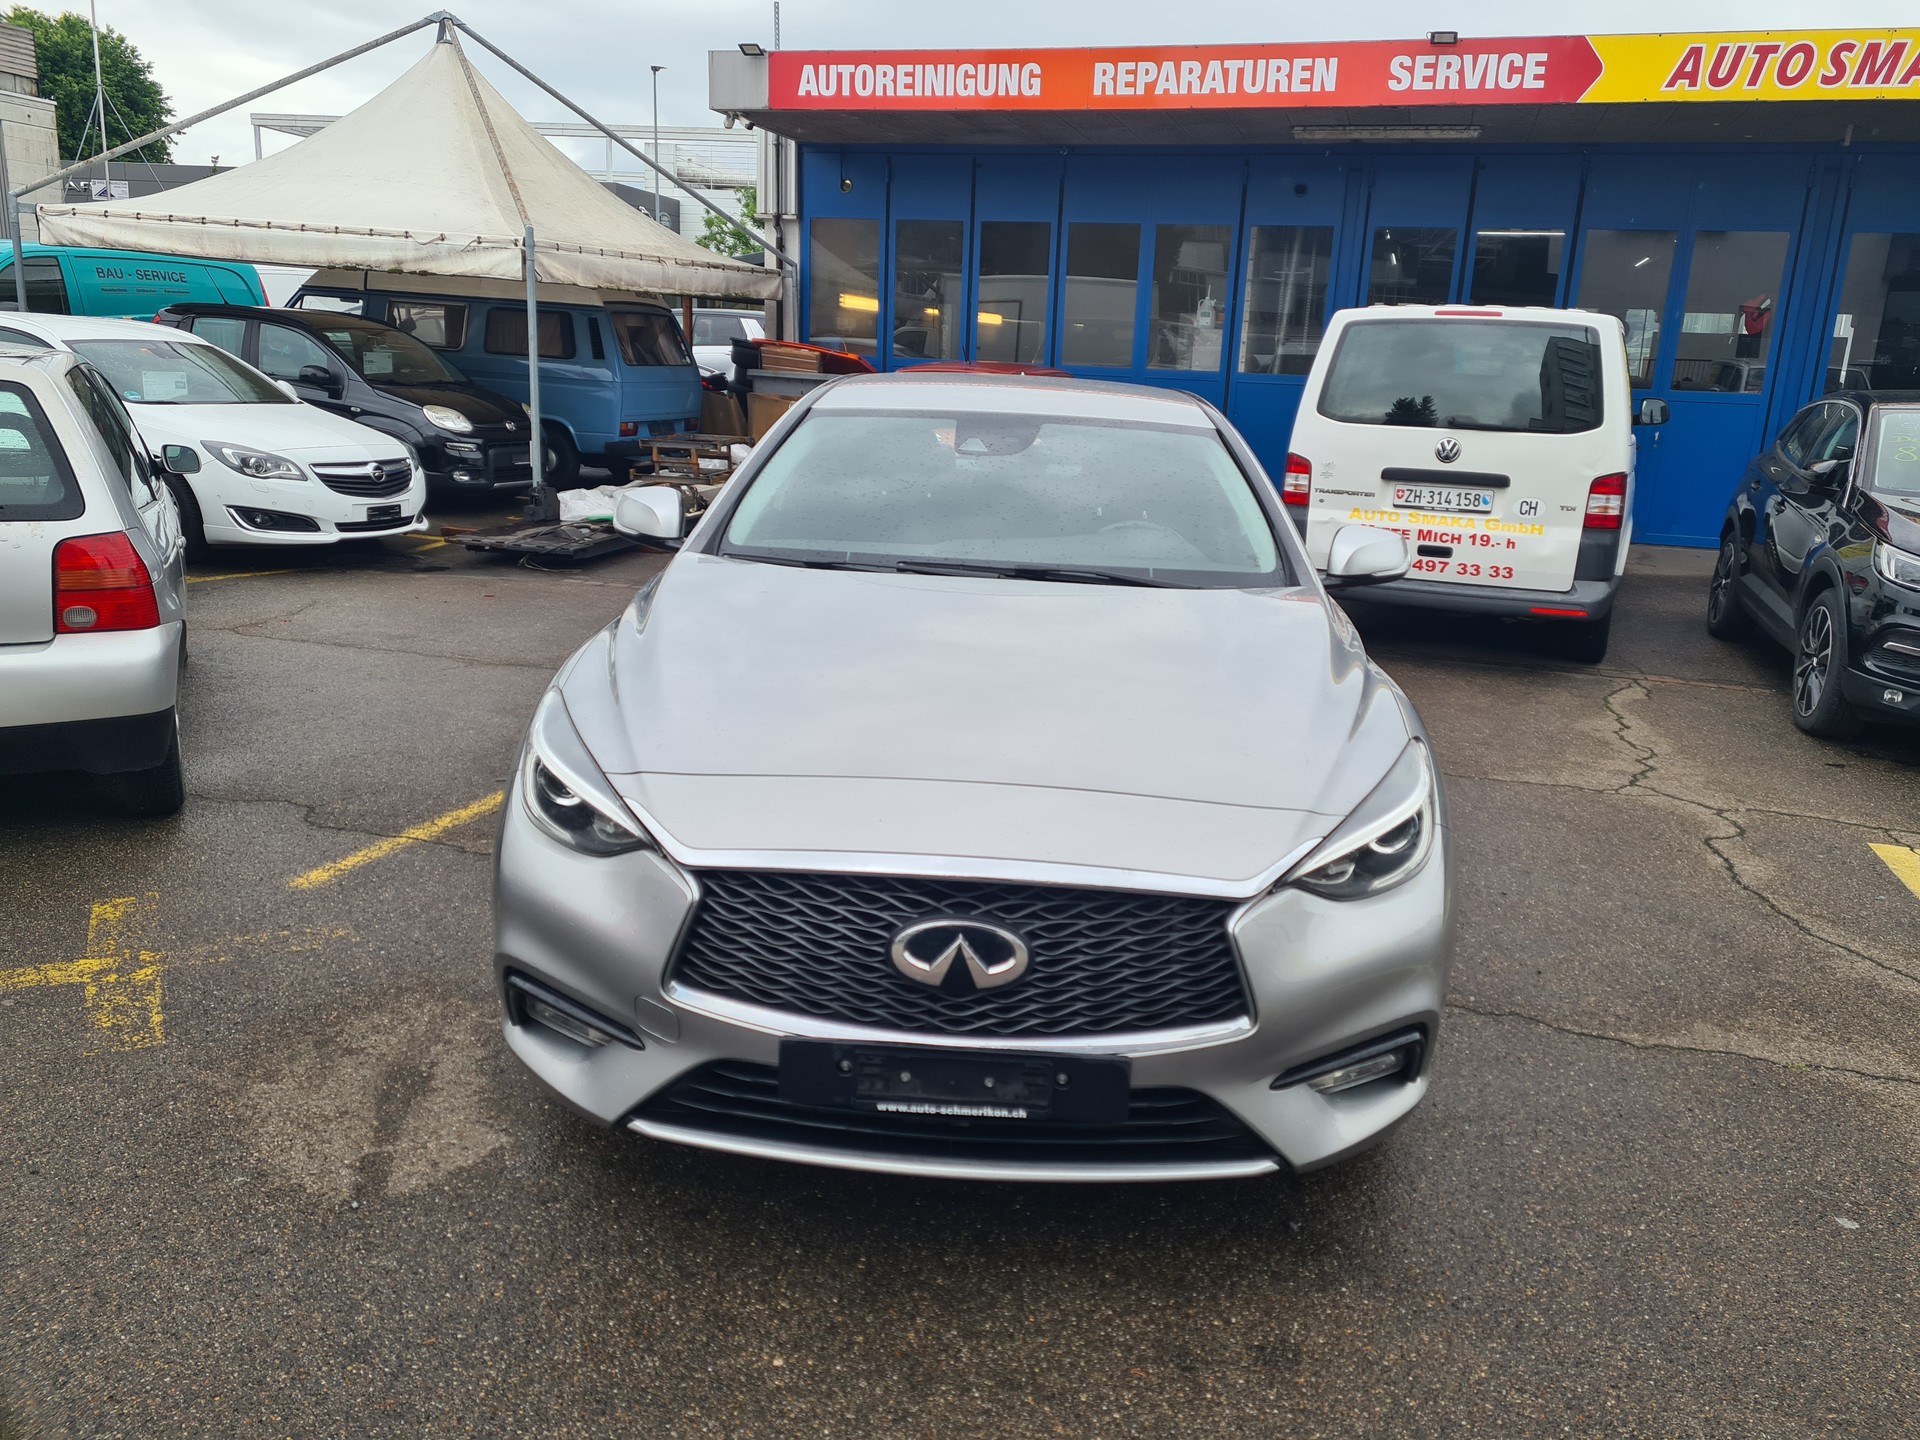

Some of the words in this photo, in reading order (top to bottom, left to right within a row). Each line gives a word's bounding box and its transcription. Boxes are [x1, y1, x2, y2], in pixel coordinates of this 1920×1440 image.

[1092, 57, 1339, 96] REPARATUREN
[1387, 53, 1549, 91] SERVICE
[1660, 40, 1818, 92] AUTO
[797, 62, 1042, 97] AUTOREINIGUNG
[95, 266, 124, 279] BAU
[135, 269, 188, 283] SERVICE
[1314, 487, 1376, 498] TRANSPORTER
[1519, 500, 1538, 517] CH
[1348, 507, 1401, 523] AUTO
[1407, 511, 1477, 530] SMAKA
[1484, 518, 1545, 536] GmbH
[1506, 537, 1516, 549] h
[1411, 558, 1450, 574] 497
[1456, 562, 1481, 577] 33
[1488, 565, 1514, 579] 33
[875, 1101, 1028, 1119] www.auto-schmerikon.ch
